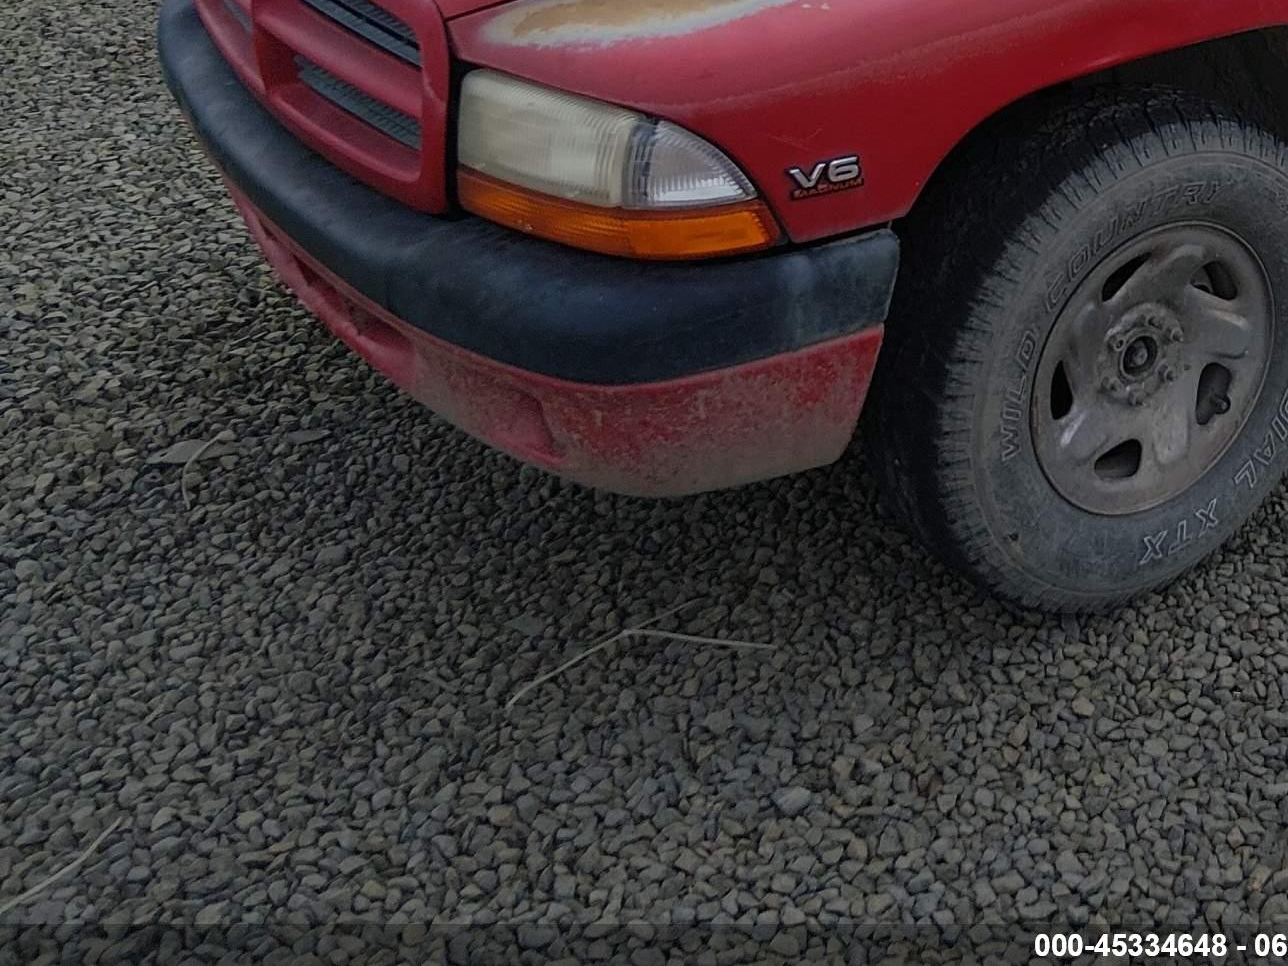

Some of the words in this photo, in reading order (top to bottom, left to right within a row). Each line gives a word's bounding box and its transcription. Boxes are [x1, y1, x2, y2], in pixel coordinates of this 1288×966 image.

[787, 155, 860, 188] V6
[1001, 329, 1037, 462] WILD
[1046, 181, 1227, 314] COUNTRY
